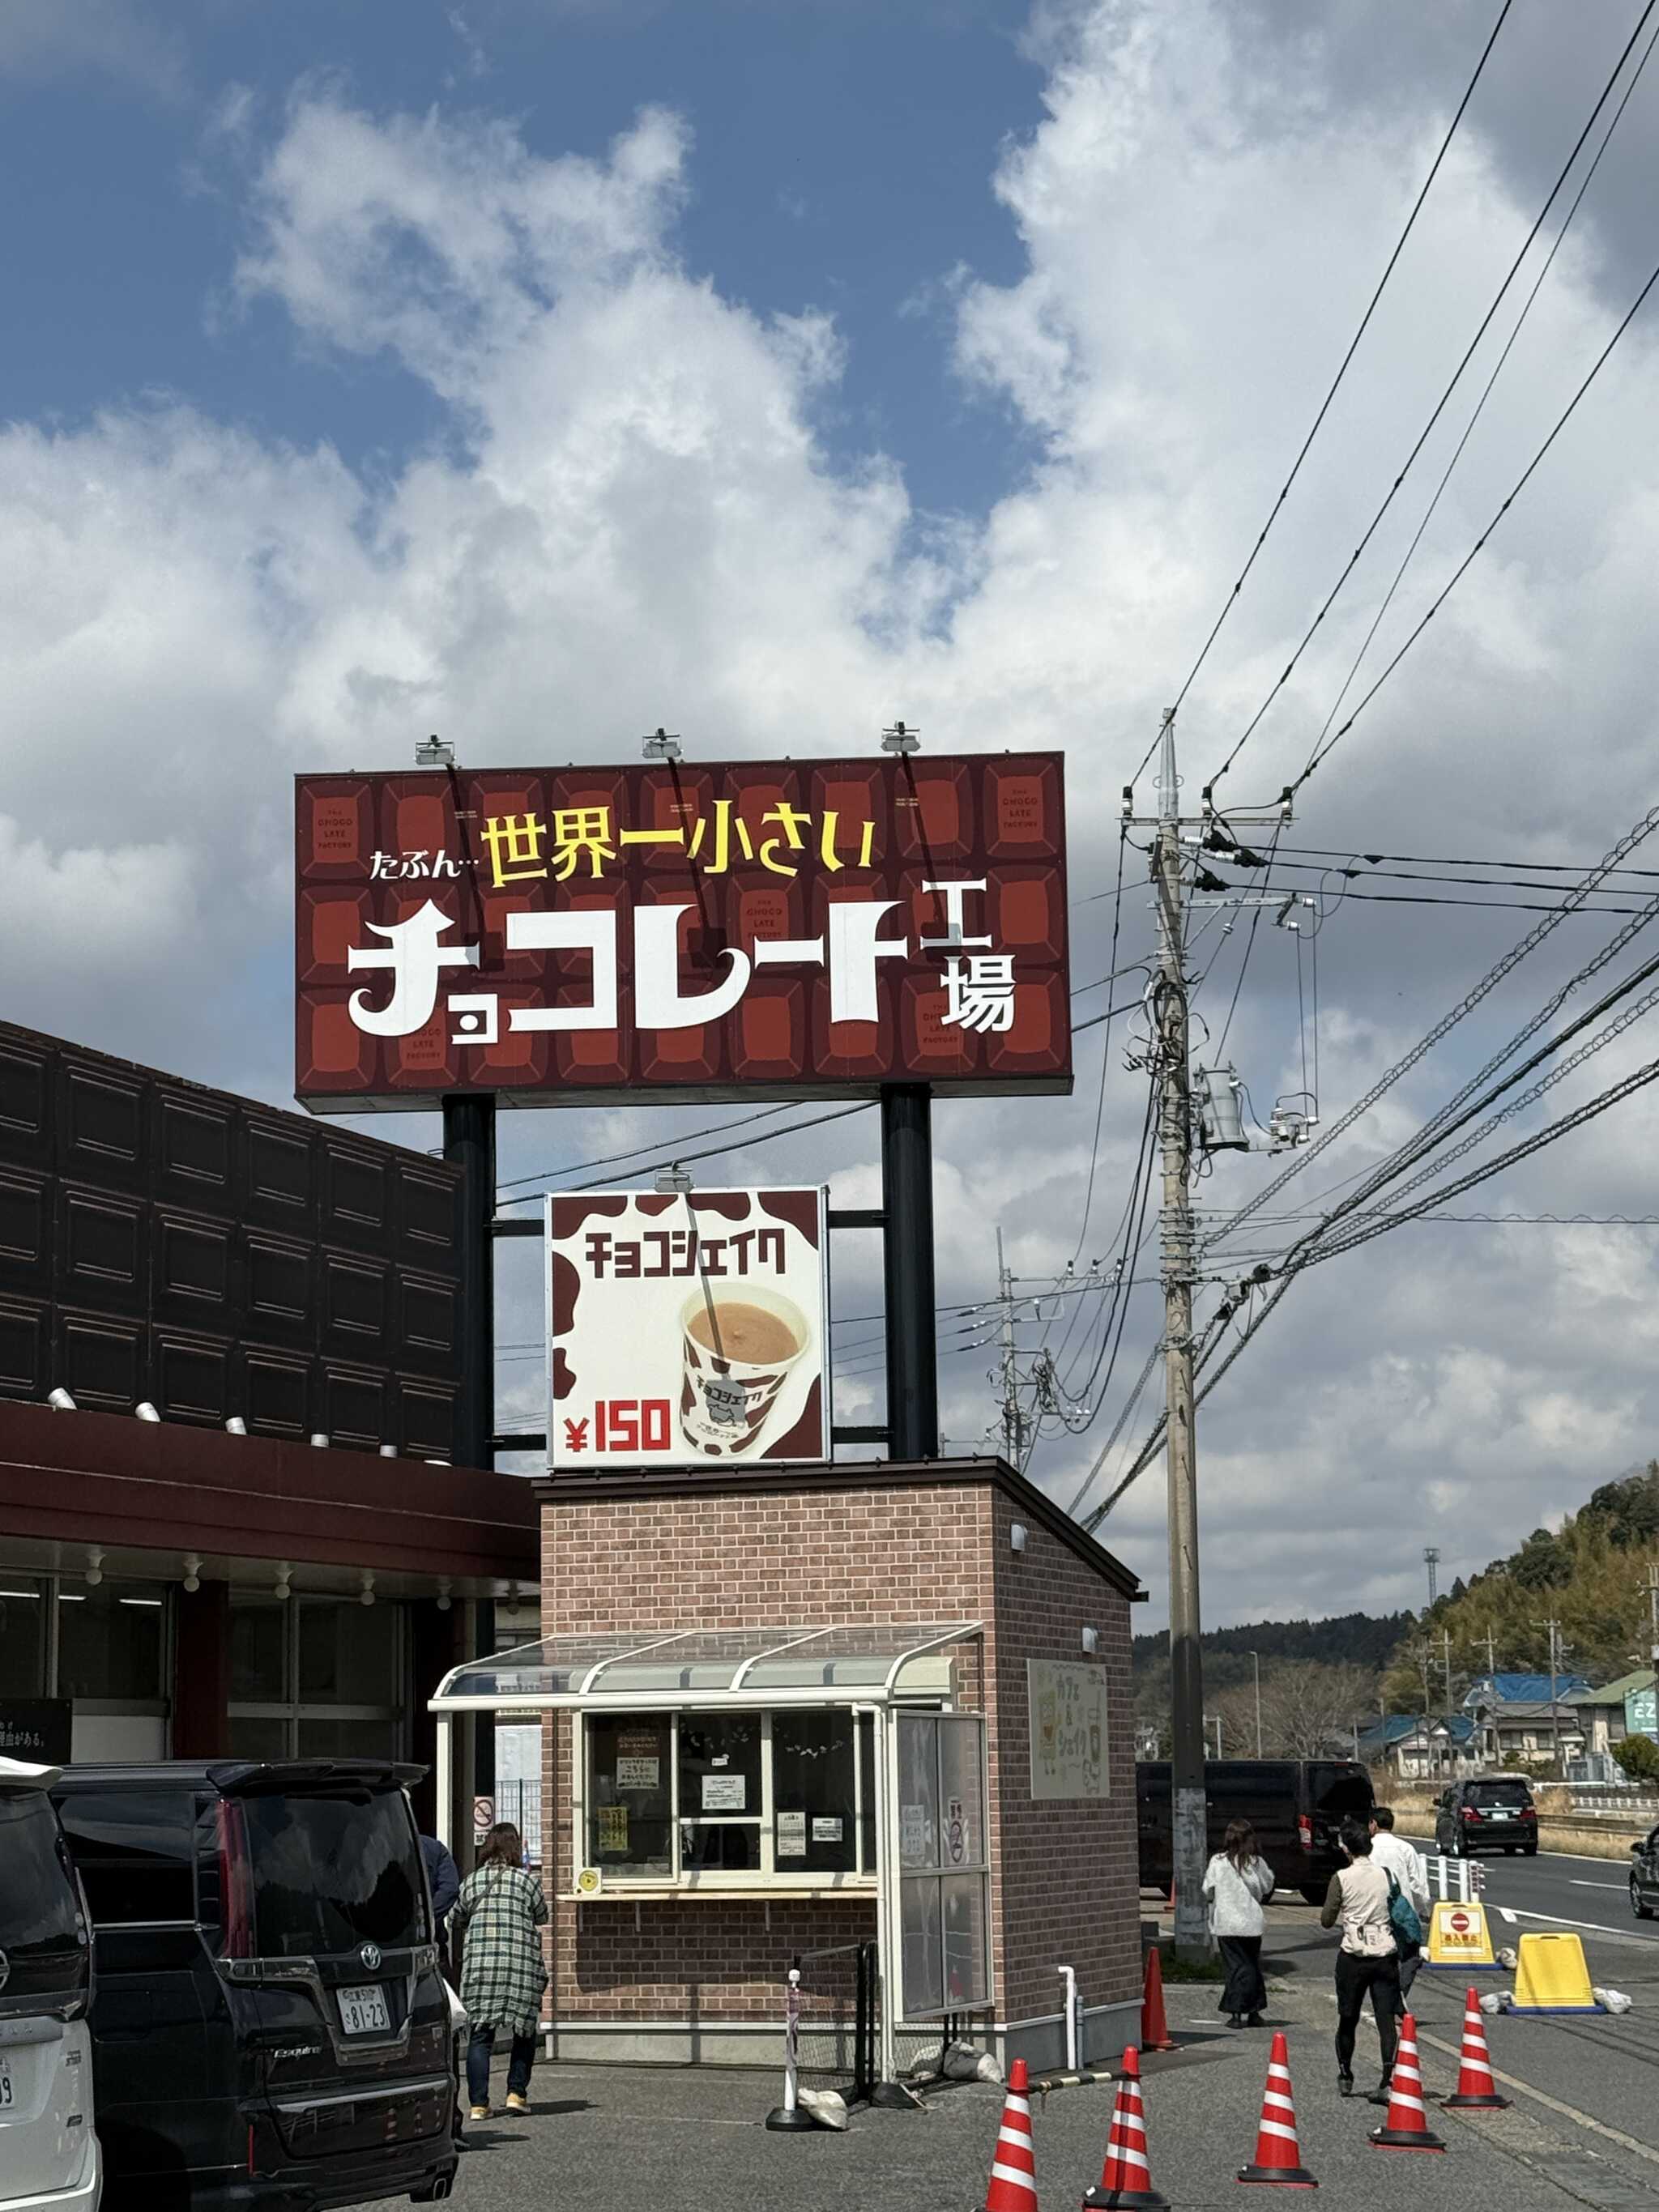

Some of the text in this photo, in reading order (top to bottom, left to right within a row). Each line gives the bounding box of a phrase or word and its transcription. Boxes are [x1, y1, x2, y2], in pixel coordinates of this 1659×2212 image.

[1003, 797, 1038, 805] CHOCO
[1009, 809, 1031, 817] LATE
[318, 818, 353, 827] CHOCO
[324, 830, 346, 838] LATE
[480, 799, 876, 889] 世界一小さい
[347, 897, 908, 1045] チョコレート
[585, 1229, 786, 1279] チョコシェイク
[563, 1398, 672, 1453] ¥150
